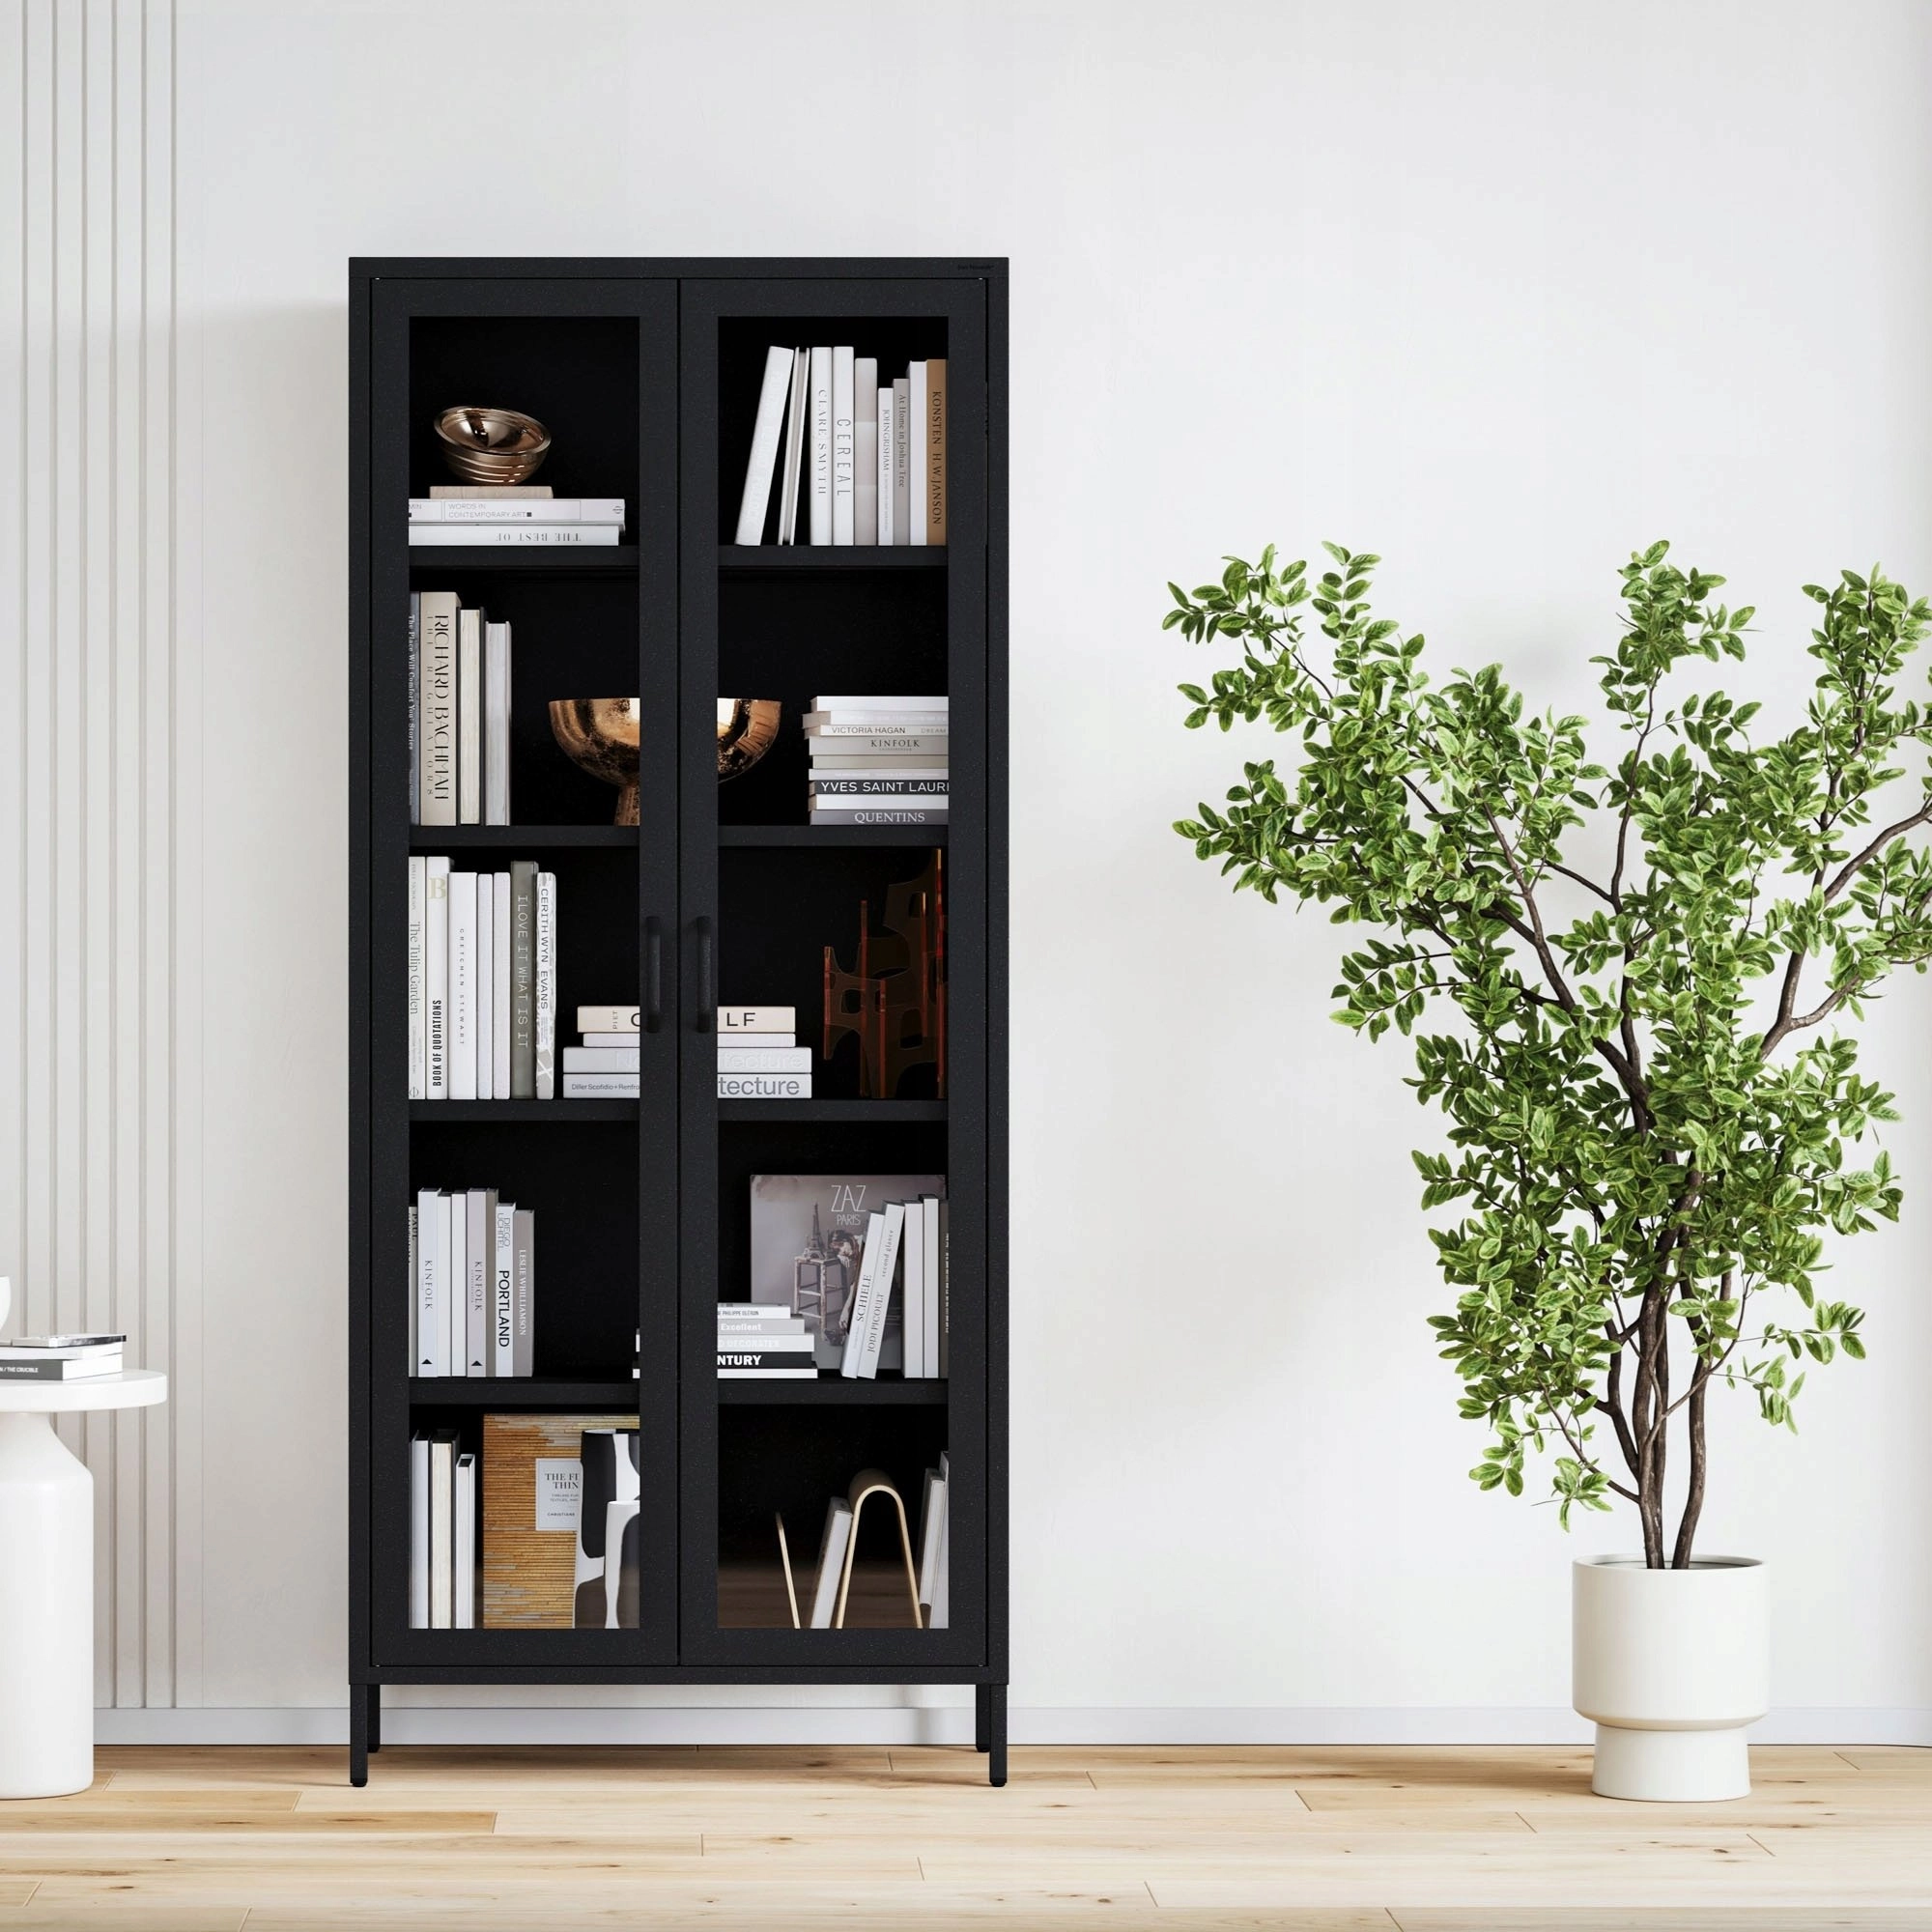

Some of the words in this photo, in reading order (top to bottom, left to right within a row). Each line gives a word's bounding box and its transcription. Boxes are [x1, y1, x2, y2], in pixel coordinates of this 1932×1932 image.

[898, 394, 907, 405] At
[818, 389, 827, 436] CLARE
[898, 407, 907, 429] Home
[932, 391, 942, 444] KONSTEN
[837, 418, 851, 497] CEREAL
[897, 440, 907, 469] Joshua
[818, 443, 827, 495] SMYTH
[898, 471, 907, 488] Tree
[496, 532, 511, 541] OF
[518, 532, 548, 541] BEST
[555, 532, 582, 541] THE
[435, 615, 450, 698] RICHARD
[435, 707, 450, 799] BACHMAN
[870, 739, 920, 748] KINFOLK
[821, 781, 858, 792] YVES
[863, 781, 904, 792] SAINT
[854, 812, 925, 823] QUENTINS
[427, 877, 446, 899] B
[540, 888, 549, 933] CERITH
[410, 921, 421, 943] The
[409, 945, 421, 972] Tulip
[517, 946, 528, 962] IT
[540, 936, 549, 963] WYN
[410, 975, 421, 1014] Garden
[517, 966, 528, 999] WHAT
[540, 970, 549, 1009] EVANS
[433, 1000, 441, 1050] QUOTATIONS
[517, 1008, 528, 1025] IS
[517, 1032, 528, 1048] IT
[433, 1053, 441, 1063] OF
[433, 1065, 441, 1087] BOOK
[831, 1184, 867, 1212] ZAZ
[837, 1214, 861, 1226] PARIS
[885, 1230, 895, 1253] glance
[474, 1261, 483, 1312] KINFOLK
[857, 1274, 872, 1321] SCHIELE
[498, 1270, 510, 1348] PORTLAND
[870, 1293, 884, 1330] PICOULT
[867, 1332, 878, 1352] JODI
